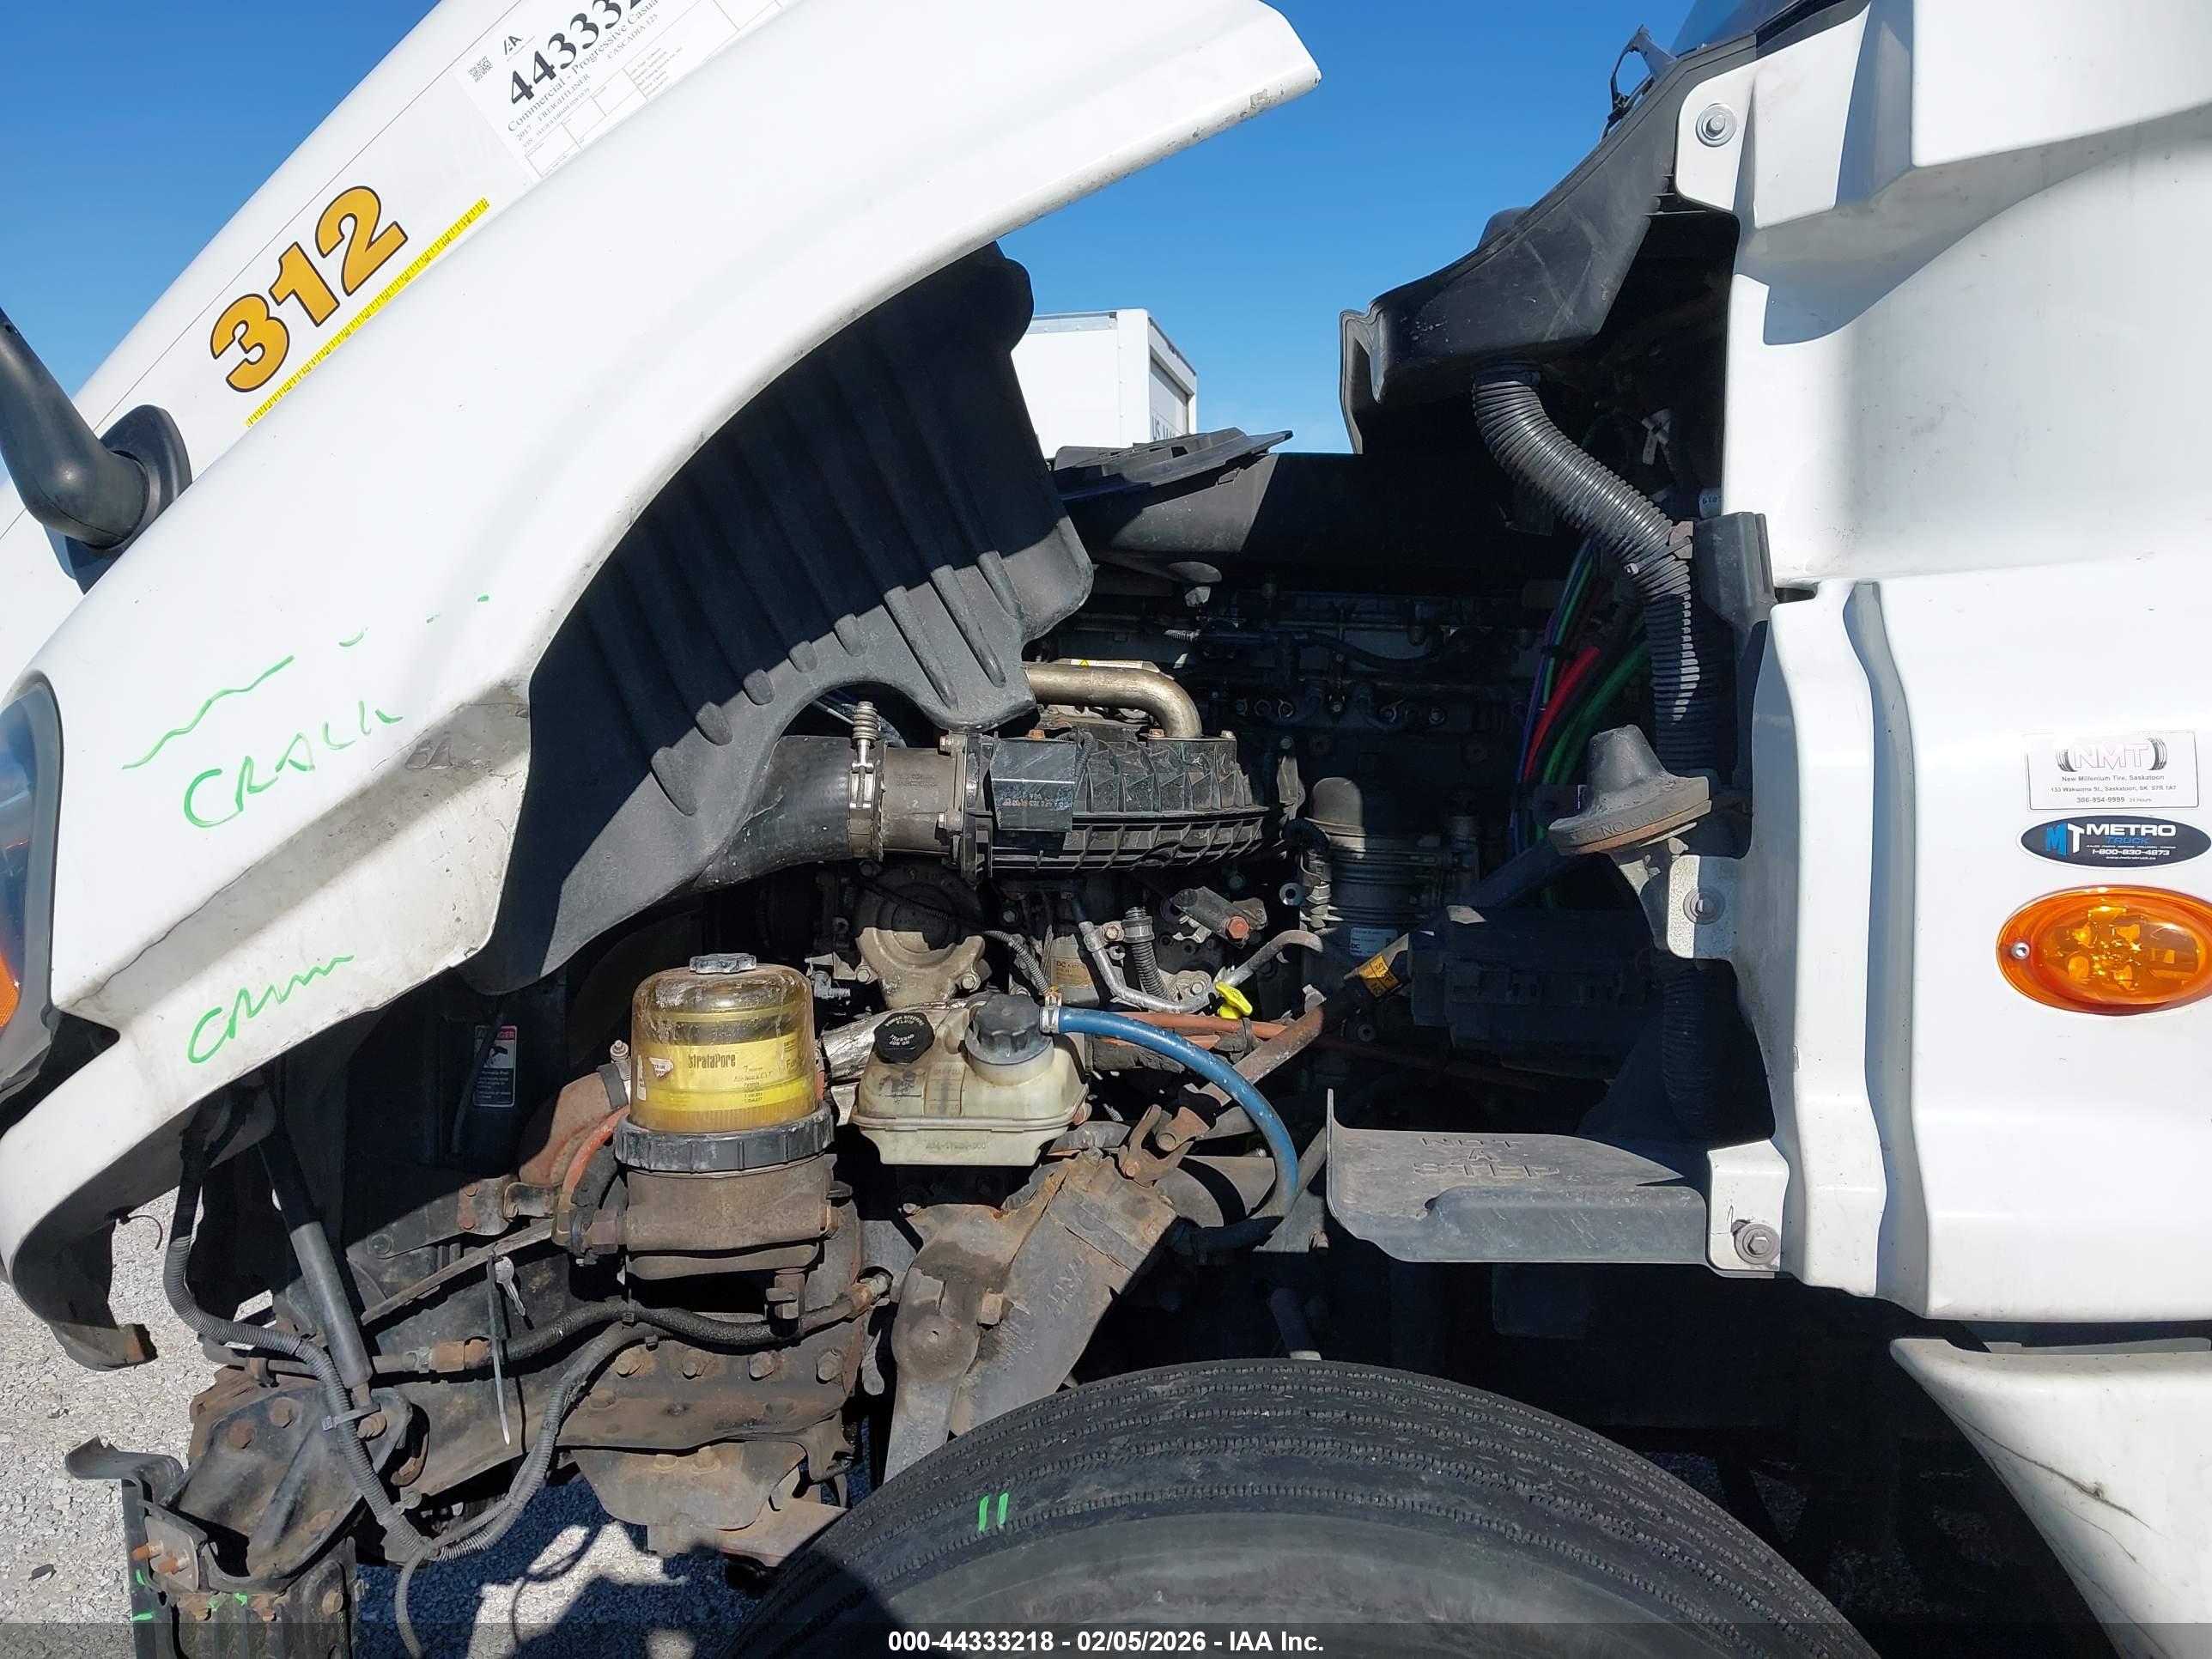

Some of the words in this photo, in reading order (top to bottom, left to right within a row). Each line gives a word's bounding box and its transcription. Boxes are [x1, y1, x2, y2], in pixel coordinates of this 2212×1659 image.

[511, 0, 642, 104] 44333
[508, 79, 566, 131] Commercial
[572, 25, 627, 76] Progressive
[517, 125, 532, 142] 2017
[537, 73, 591, 122] FREIGHTLINER
[607, 25, 646, 59] CASCADIA
[210, 185, 409, 392] 312
[2073, 743, 2149, 770] NMT
[2086, 823, 2177, 836] METRO
[1421, 1137, 1524, 1149] NOT
[1468, 1147, 1501, 1162] A
[1413, 1162, 1560, 1179] STEP
